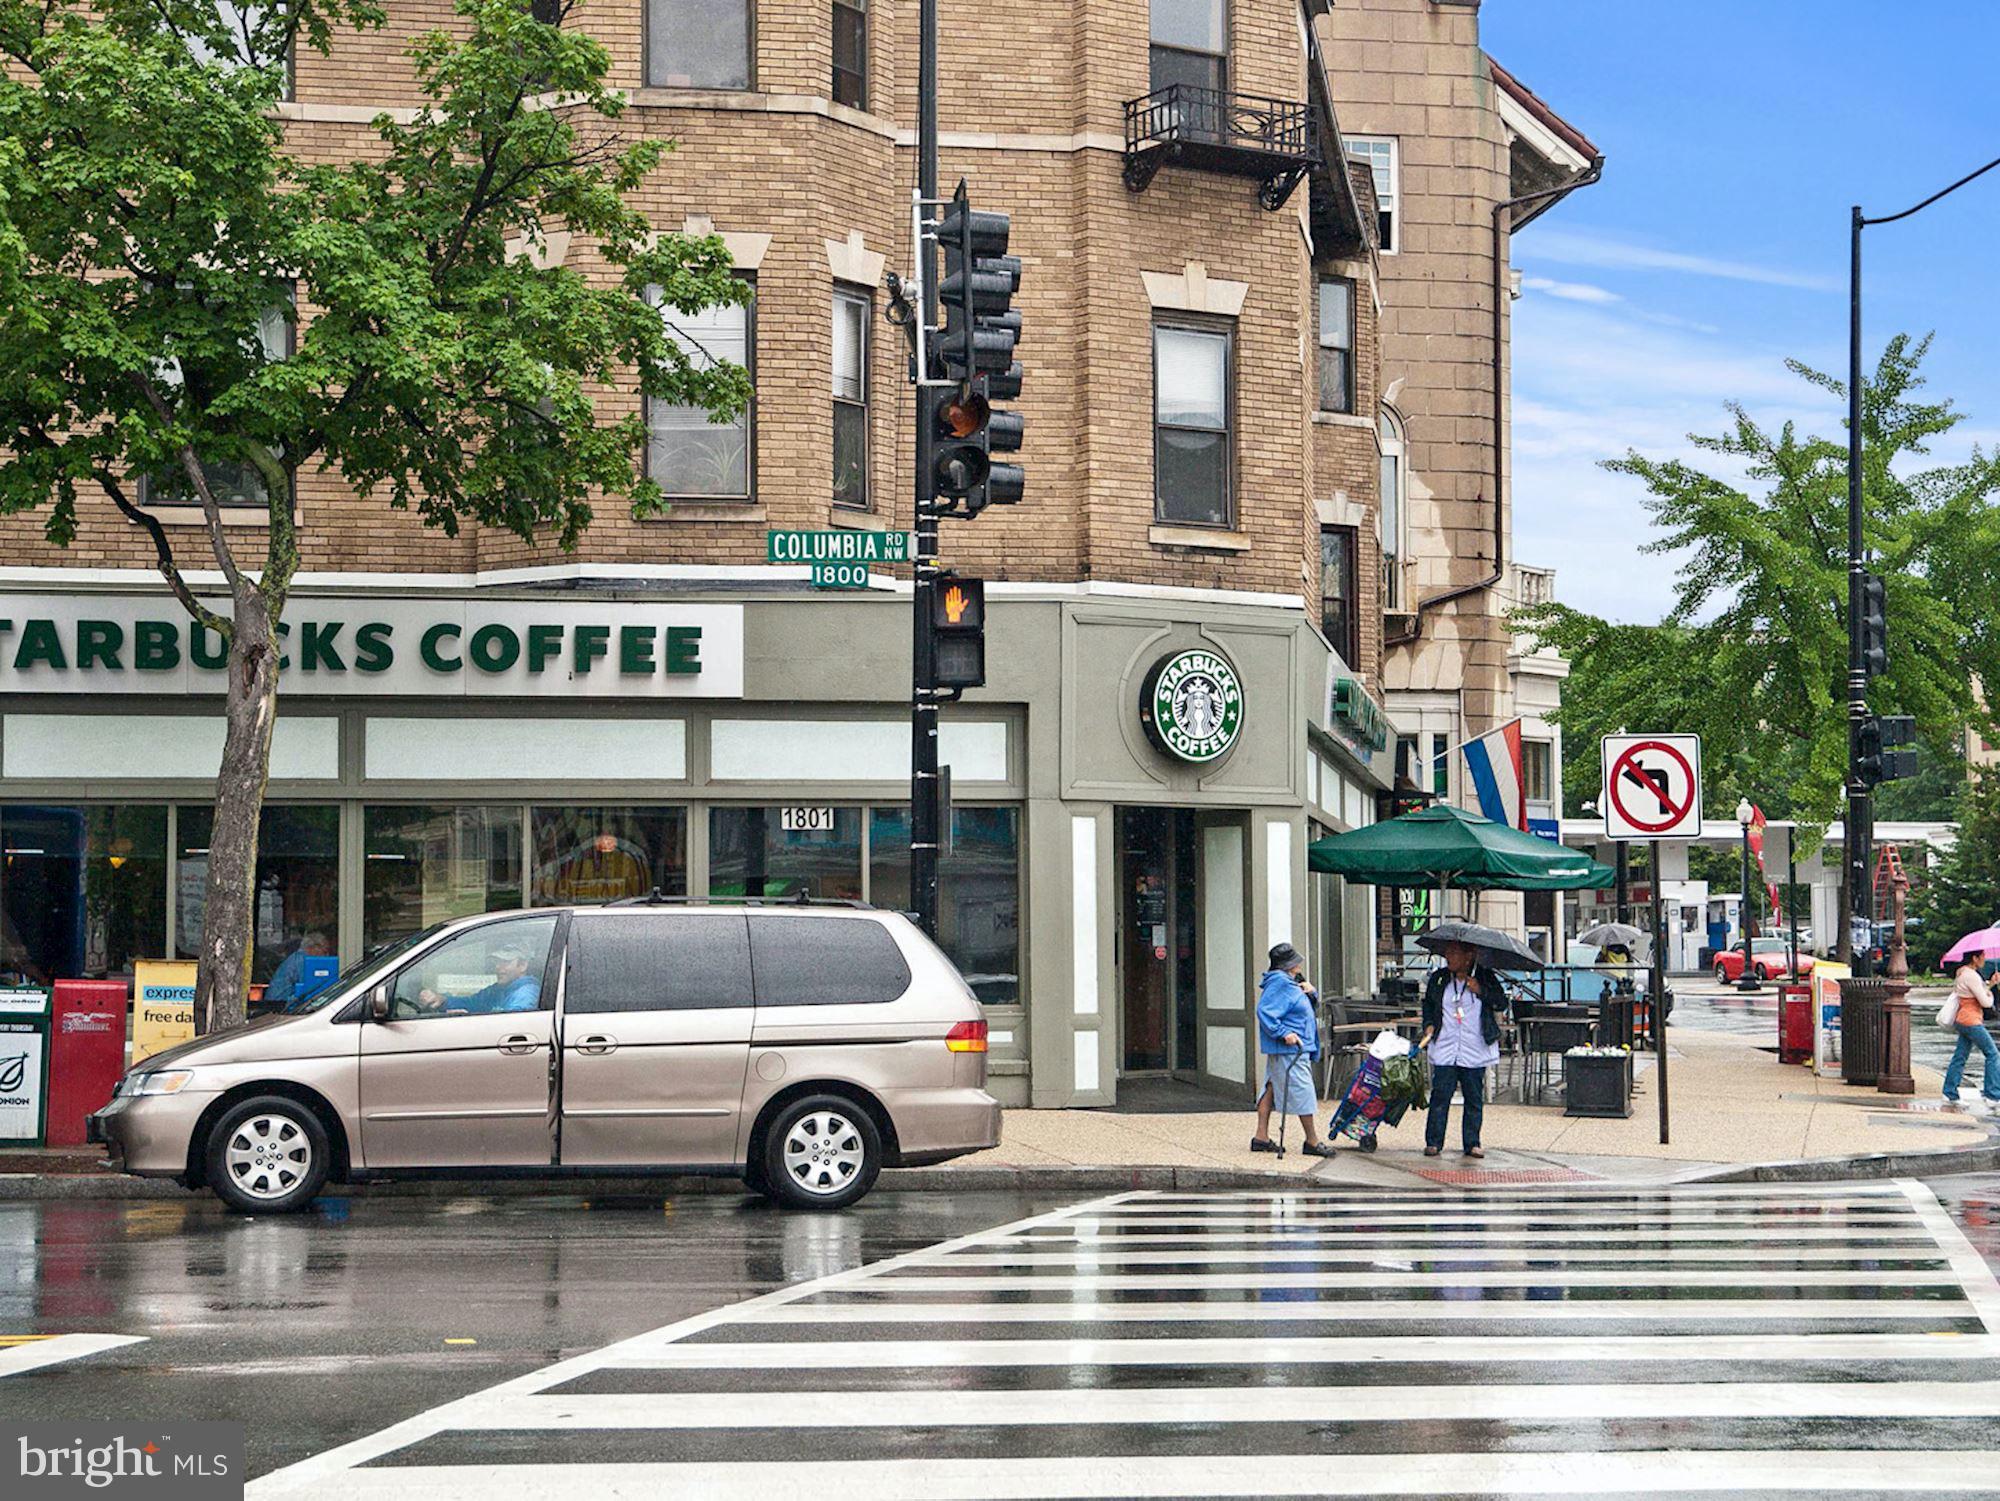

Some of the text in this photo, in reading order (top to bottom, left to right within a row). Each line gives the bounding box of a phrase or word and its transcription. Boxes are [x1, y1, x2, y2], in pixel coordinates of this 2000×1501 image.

[774, 533, 903, 559] COLUMBIA RD
[884, 546, 903, 559] NW
[815, 566, 867, 585] 1800
[420, 622, 703, 674] COFFEE
[1158, 655, 1238, 704] STARBUCKS
[1167, 726, 1230, 756] COFFEE
[784, 807, 830, 828] 1801
[146, 988, 197, 1000] expres
[144, 1009, 193, 1023] free da
